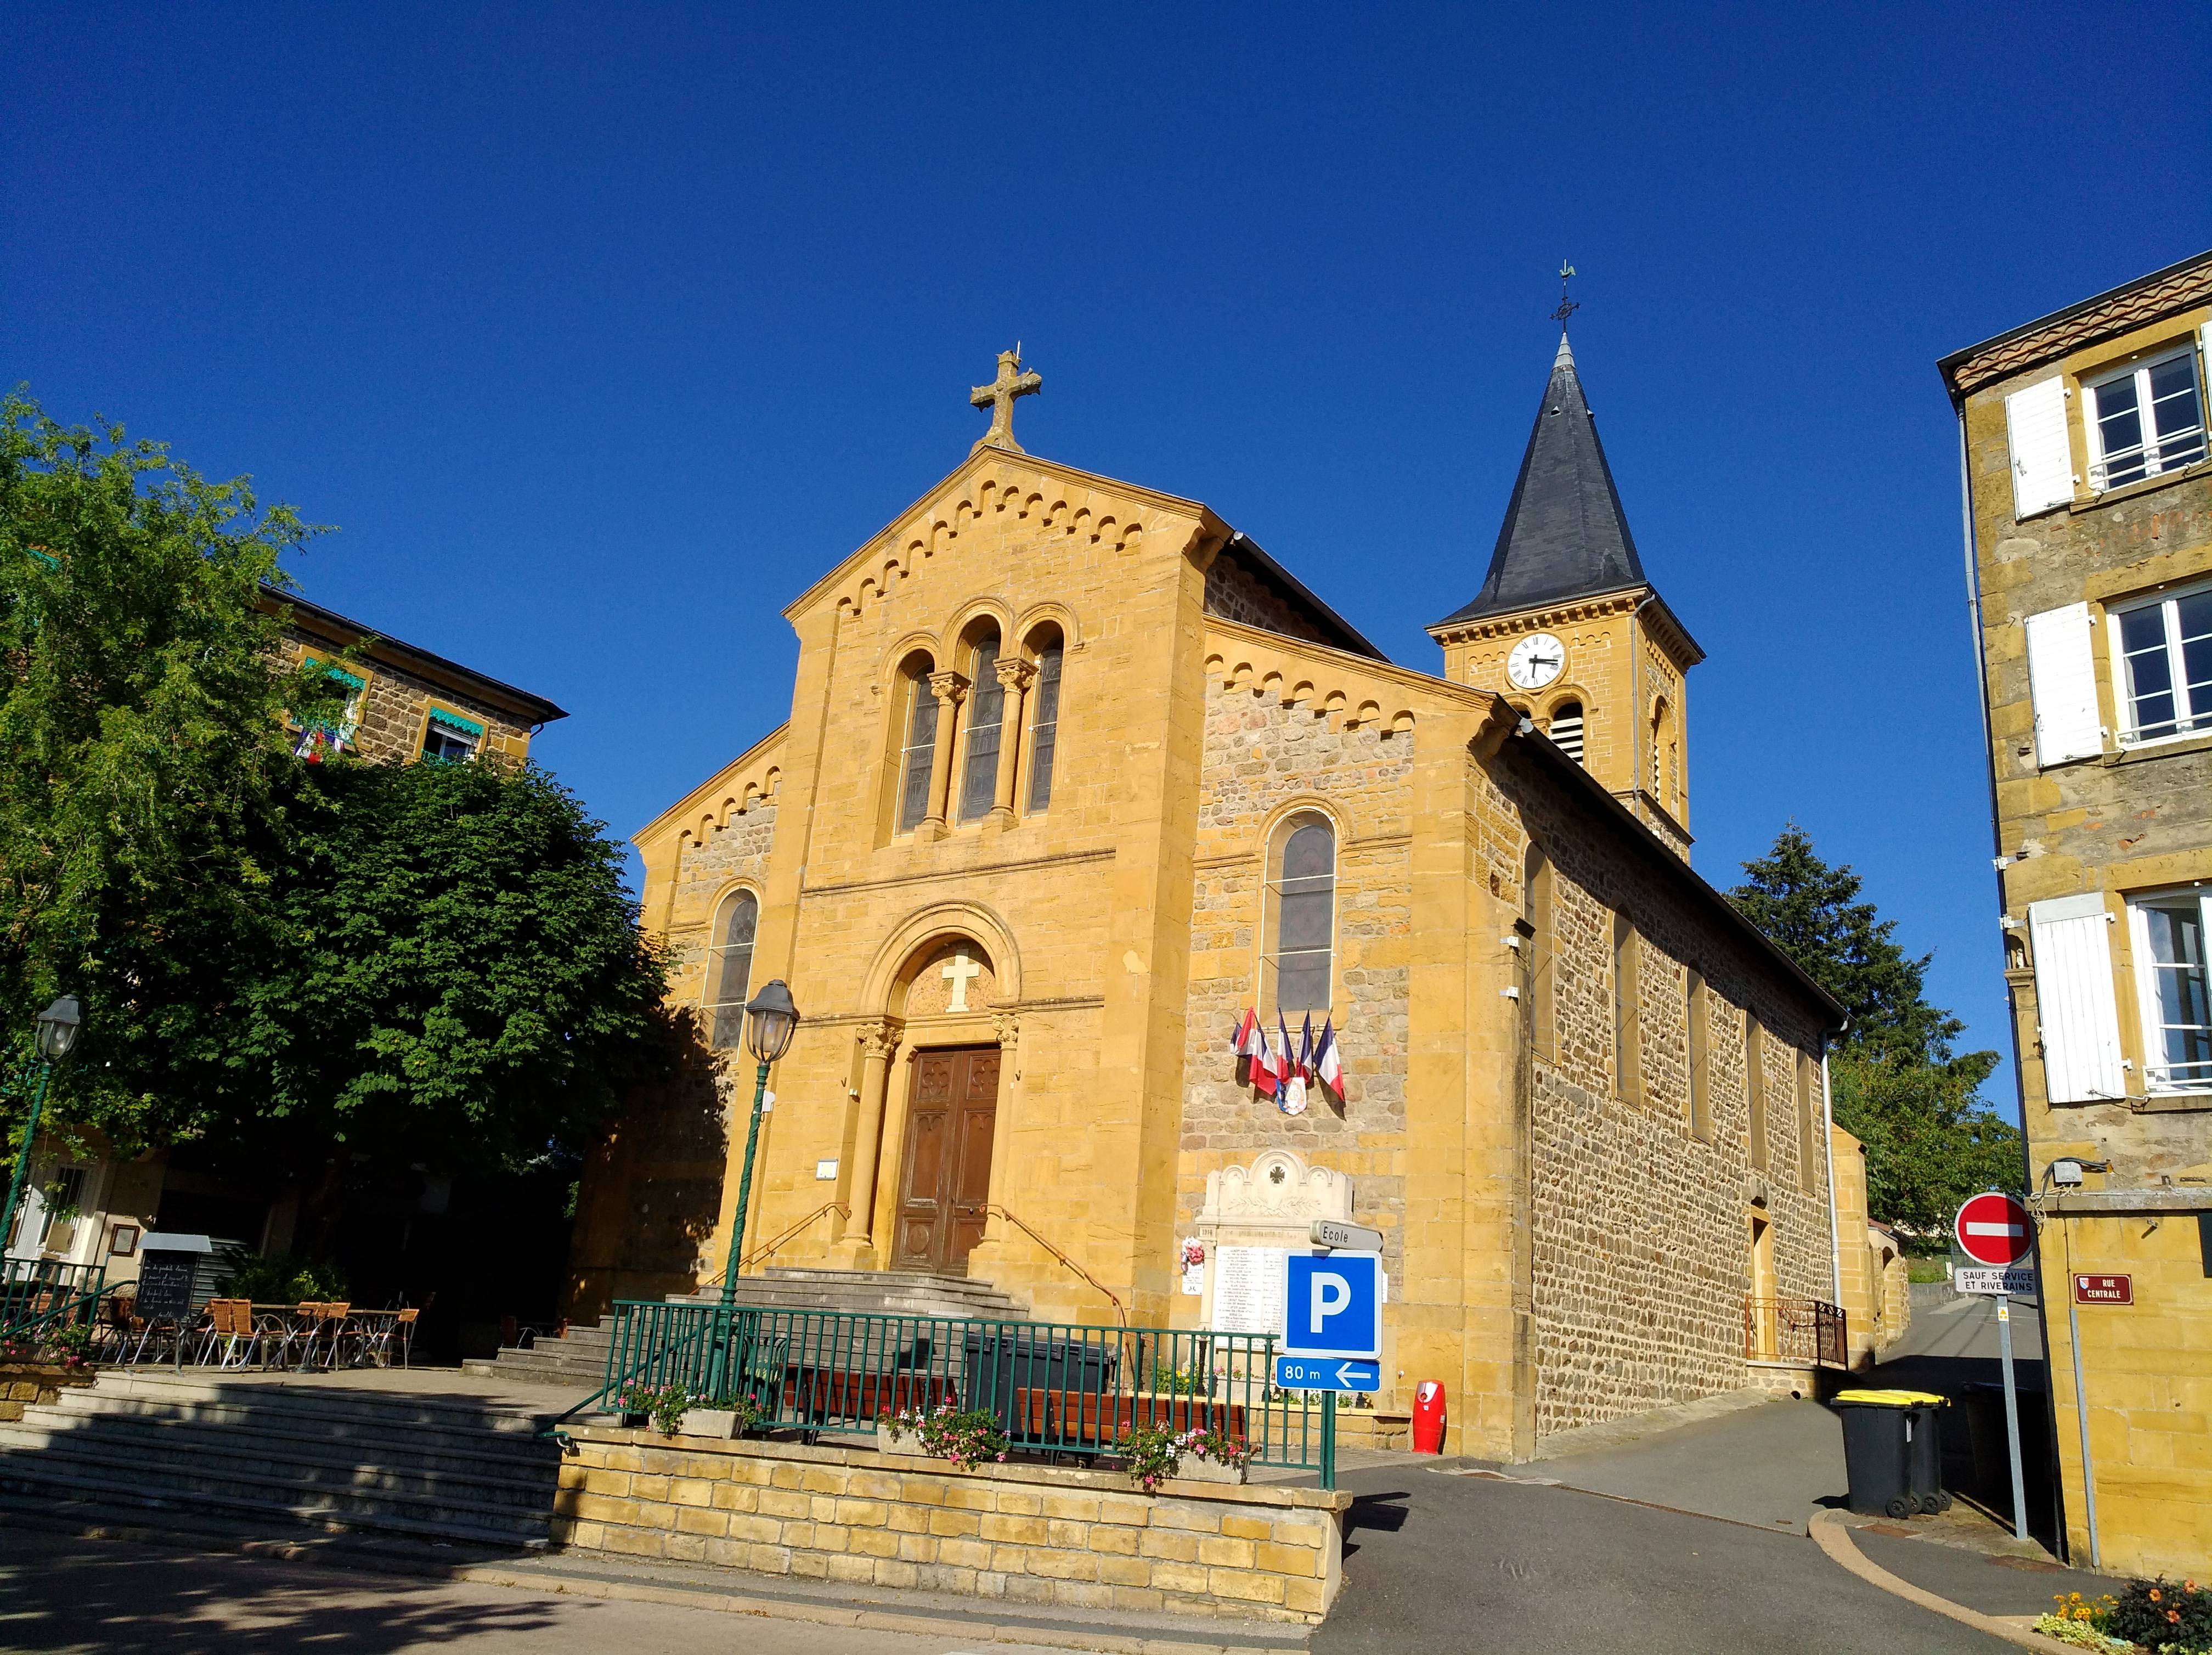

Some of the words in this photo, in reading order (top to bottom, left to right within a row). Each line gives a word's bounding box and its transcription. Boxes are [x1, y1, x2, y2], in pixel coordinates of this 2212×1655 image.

[1963, 1271, 1986, 1280] SAUF
[1992, 1272, 2033, 1281] SERVICE
[1981, 1282, 2033, 1291] RIVERAINS
[2102, 1279, 2115, 1287] RUE
[2087, 1290, 2121, 1298] CENTRALE
[1310, 1271, 1351, 1333] P
[1285, 1365, 1304, 1380] 80
[1310, 1371, 1321, 1380] m
